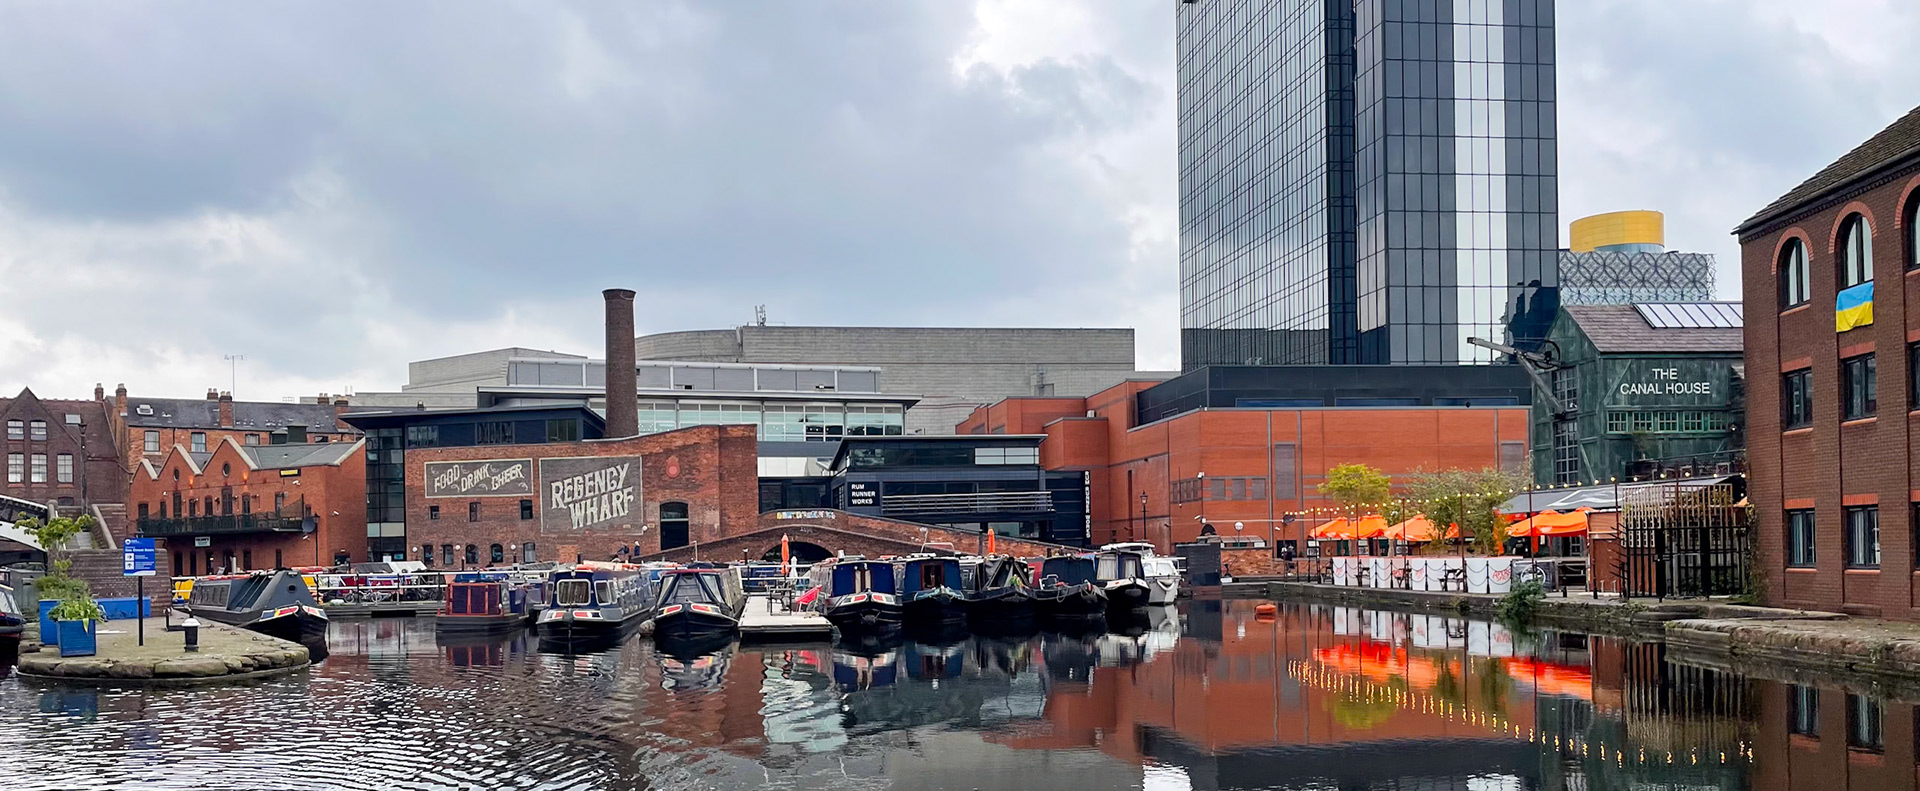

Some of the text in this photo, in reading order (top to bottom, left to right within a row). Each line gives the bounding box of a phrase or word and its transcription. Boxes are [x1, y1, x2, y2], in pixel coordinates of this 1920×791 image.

[1620, 382, 1710, 394] CANAL HOUSE
[1652, 368, 1677, 379] THE
[434, 463, 525, 493] FOOD DRINK CHEER
[551, 463, 629, 509] REGENCY
[569, 486, 634, 529] WHARF
